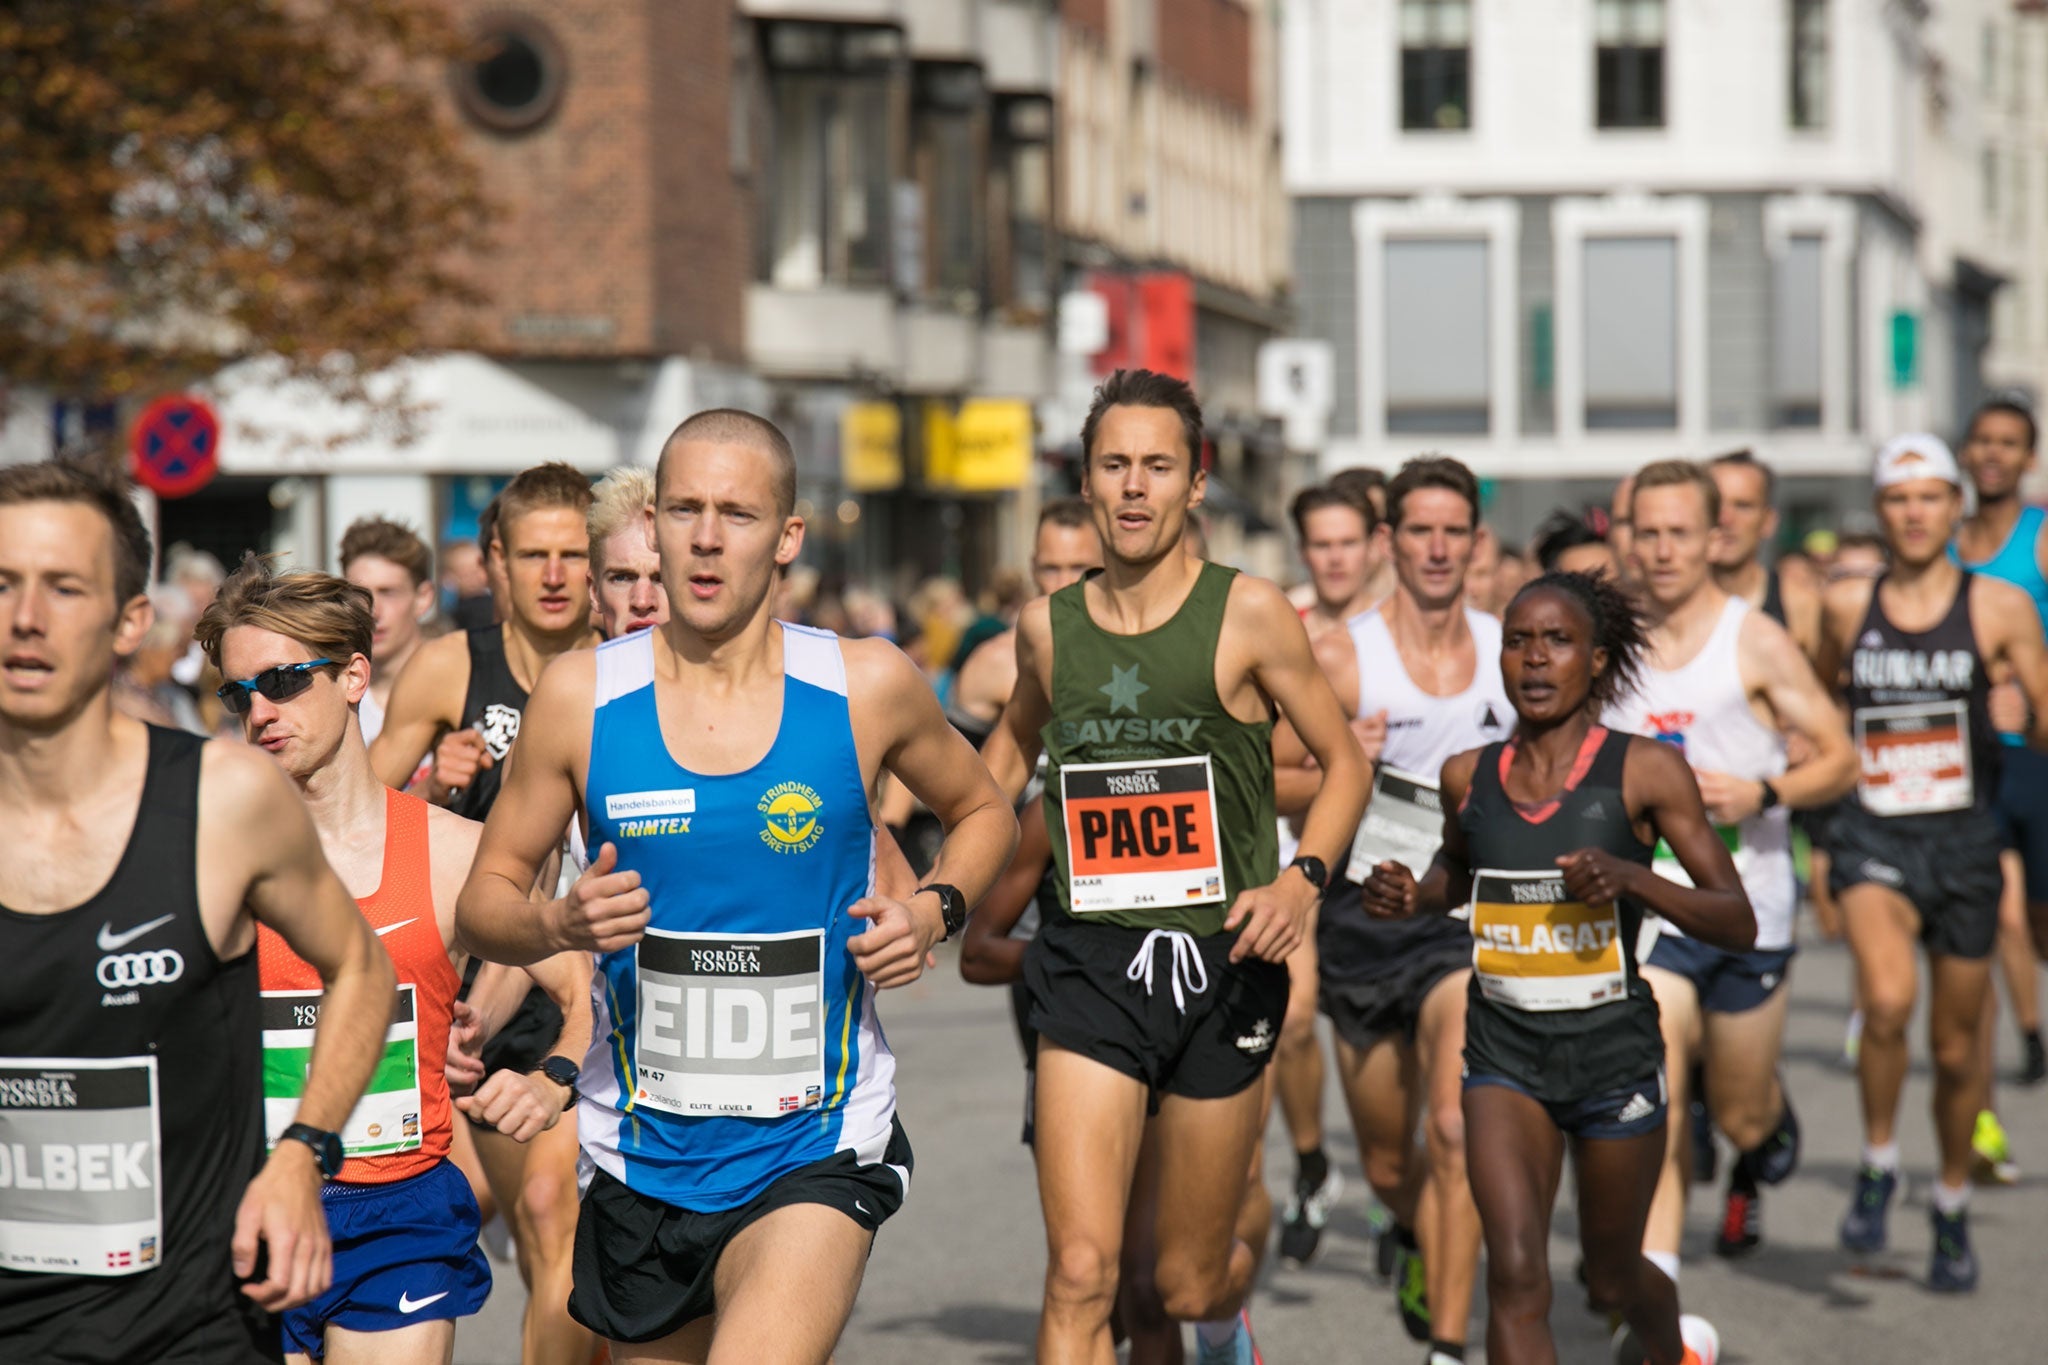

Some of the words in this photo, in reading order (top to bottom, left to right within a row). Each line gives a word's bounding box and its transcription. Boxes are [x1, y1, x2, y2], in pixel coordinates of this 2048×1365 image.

[1060, 718, 1203, 744] SAYSKY
[610, 796, 691, 811] Handelsbanken
[757, 781, 823, 812] STRINDHEIM
[619, 817, 692, 837] TRIMTEX
[1080, 804, 1200, 859] PACE
[759, 825, 824, 855] IDRETTSLAG
[1480, 920, 1614, 954] JELAGAT
[691, 949, 757, 962] NORDEA
[694, 960, 760, 973] FONDEN
[101, 990, 140, 1007] Audi
[641, 980, 817, 1059] EIDE
[639, 1068, 648, 1079] M
[651, 1072, 665, 1082] 47
[649, 1093, 682, 1108] zalando
